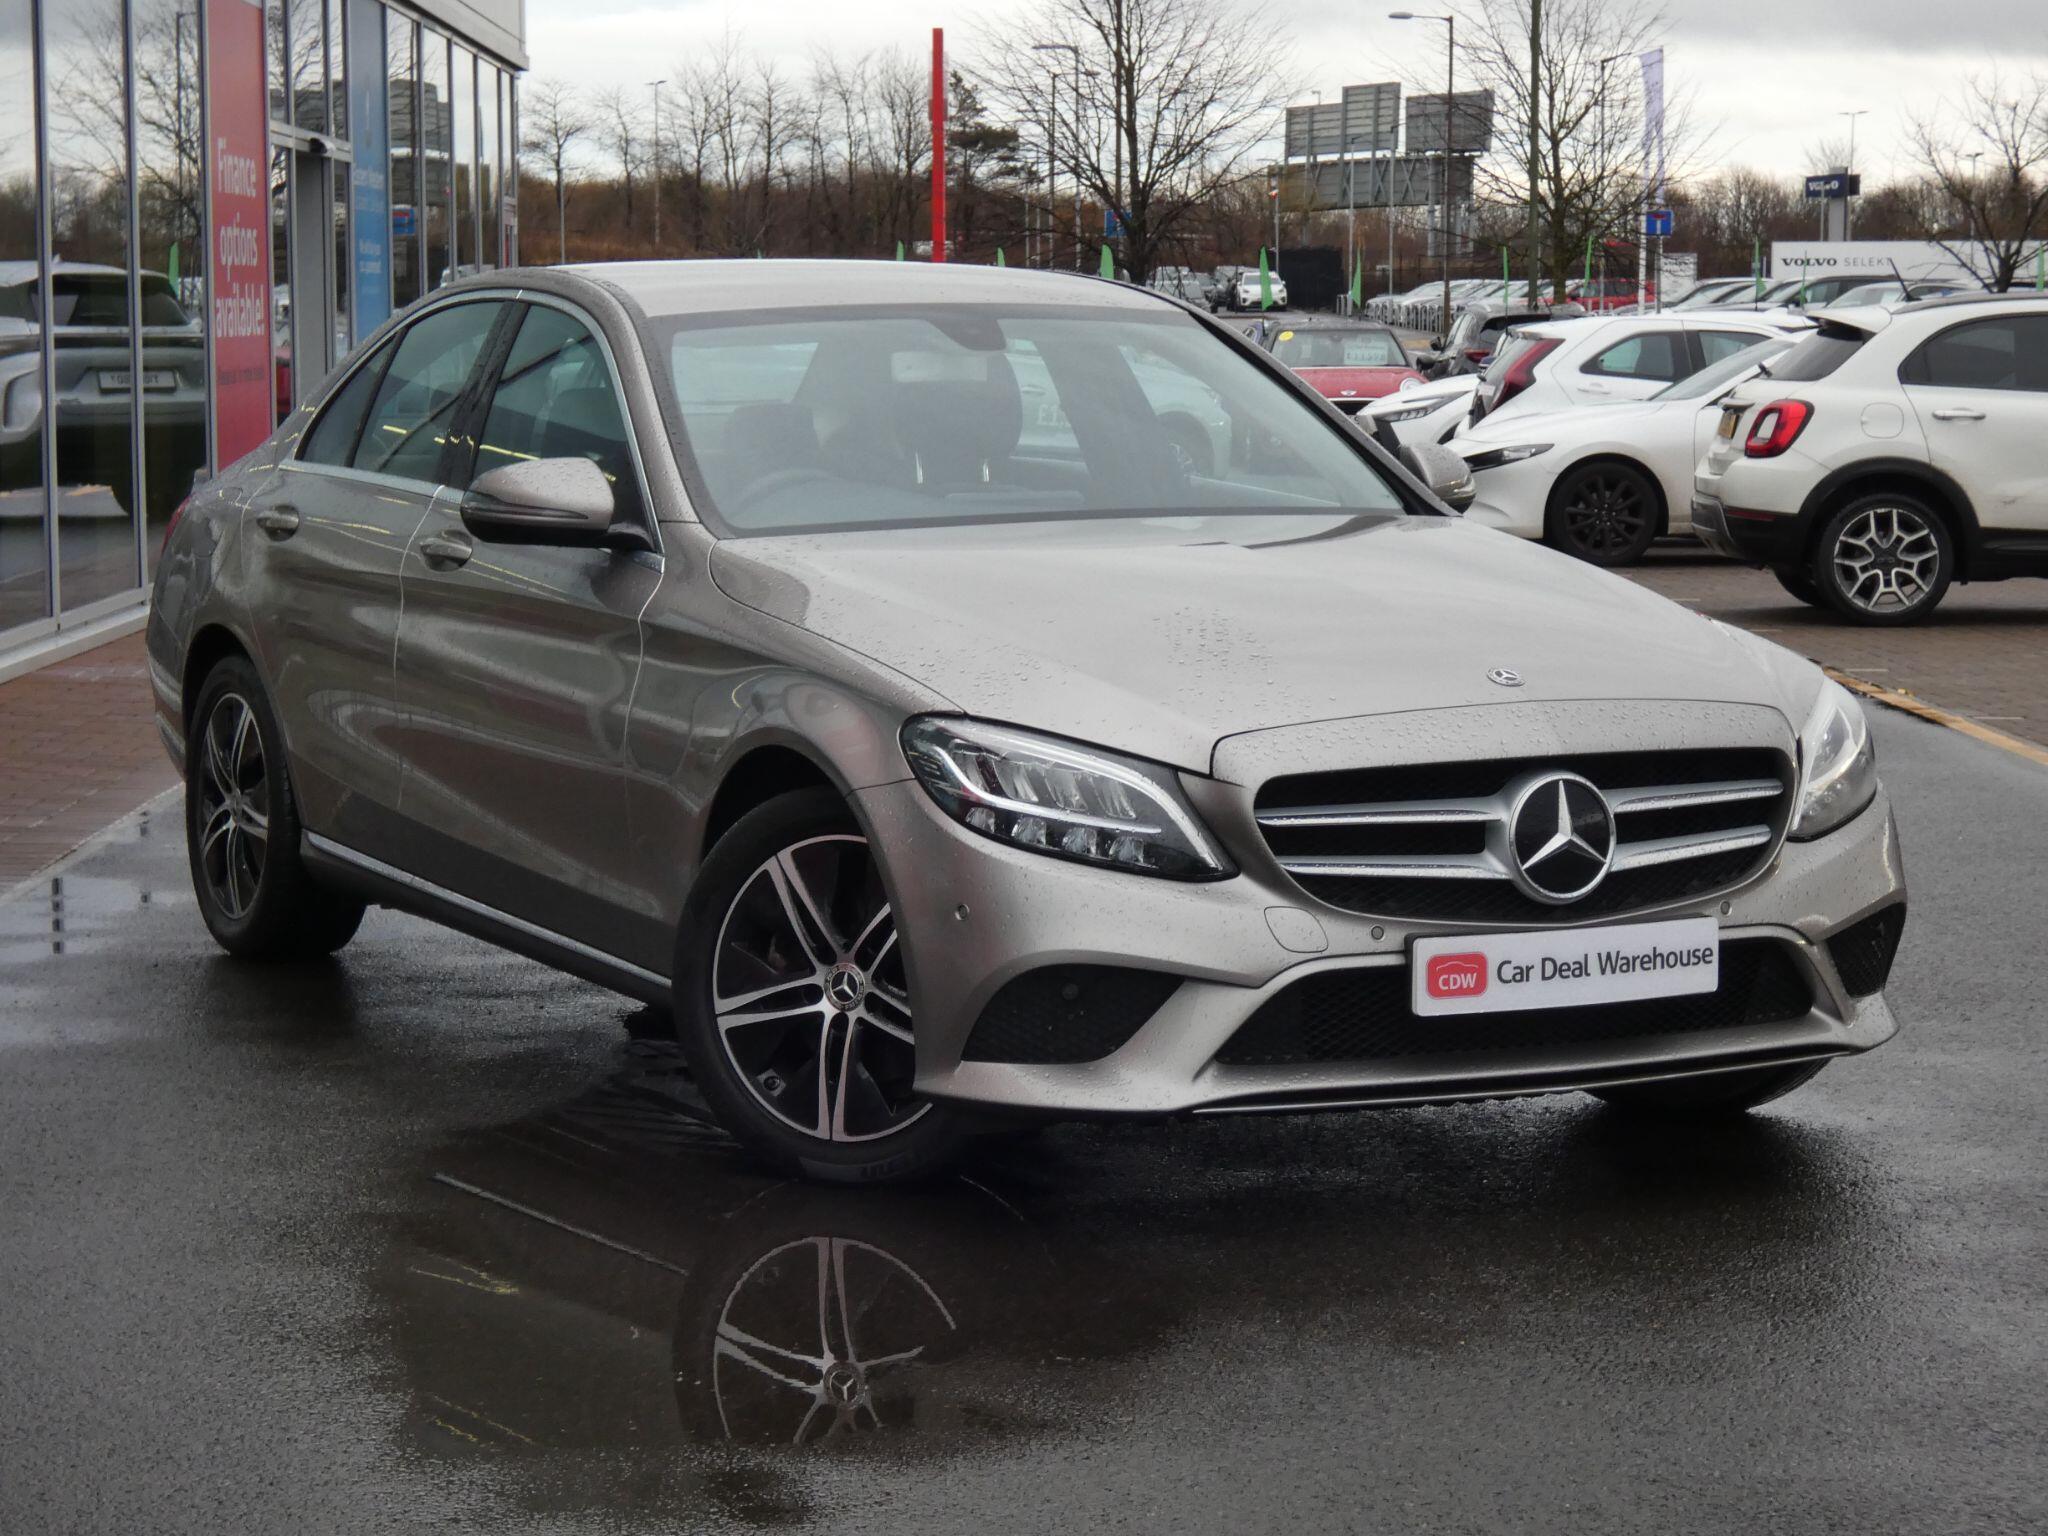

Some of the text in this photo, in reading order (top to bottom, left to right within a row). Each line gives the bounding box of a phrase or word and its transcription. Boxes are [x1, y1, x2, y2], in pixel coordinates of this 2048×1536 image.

[217, 138, 257, 198] Finance
[220, 211, 258, 282] options
[1781, 257, 1837, 267] VOLVO
[216, 283, 265, 337] available!
[1438, 972, 1478, 991] CDW
[1496, 946, 1714, 985] Car Deal Warehouse
